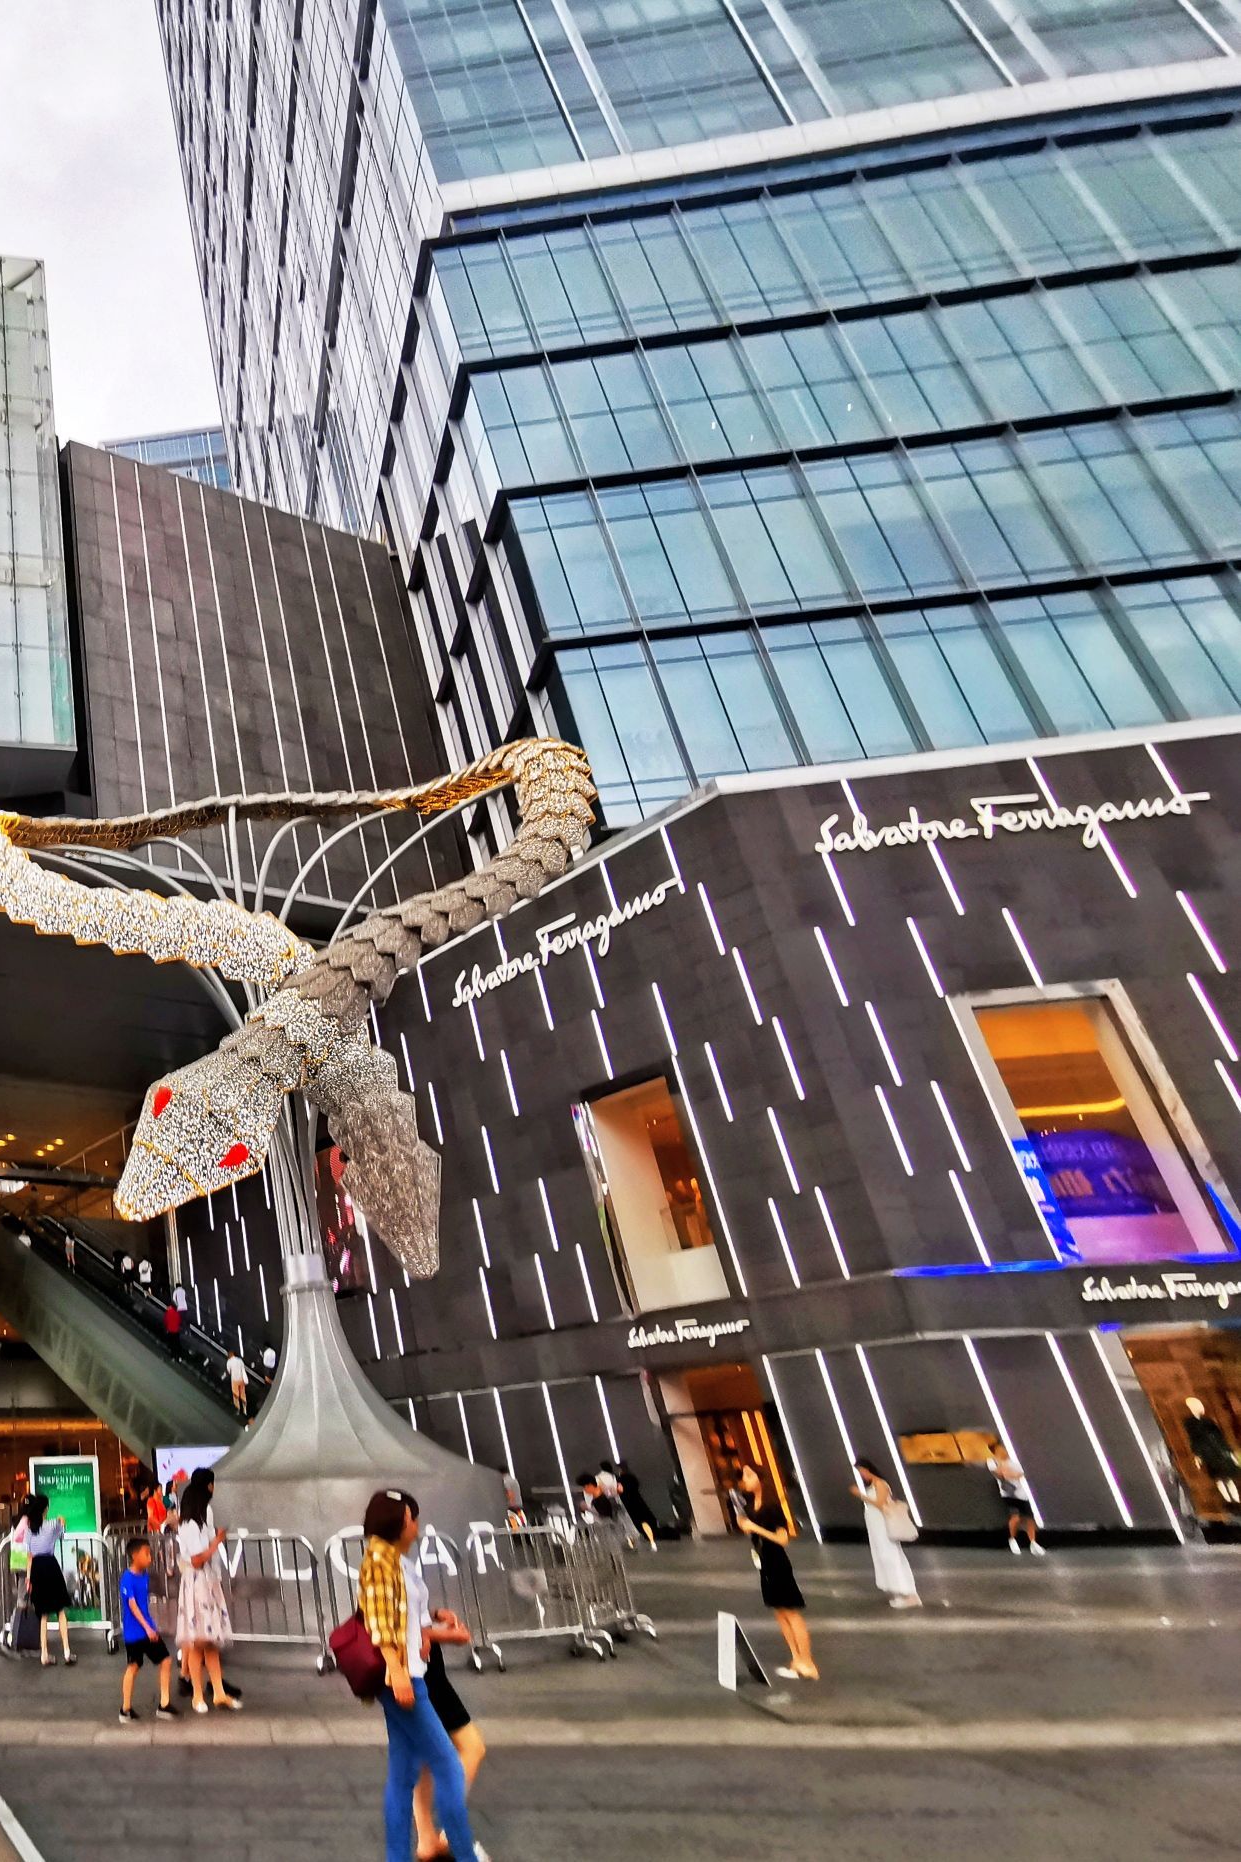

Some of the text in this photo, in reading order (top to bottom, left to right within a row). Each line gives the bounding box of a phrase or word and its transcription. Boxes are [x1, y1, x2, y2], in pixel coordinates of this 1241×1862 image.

[814, 791, 1211, 854] Salvatore Ferragamo
[452, 876, 681, 1008] Salvatore Ferragamo
[1160, 1272, 1241, 1310] Ferraga
